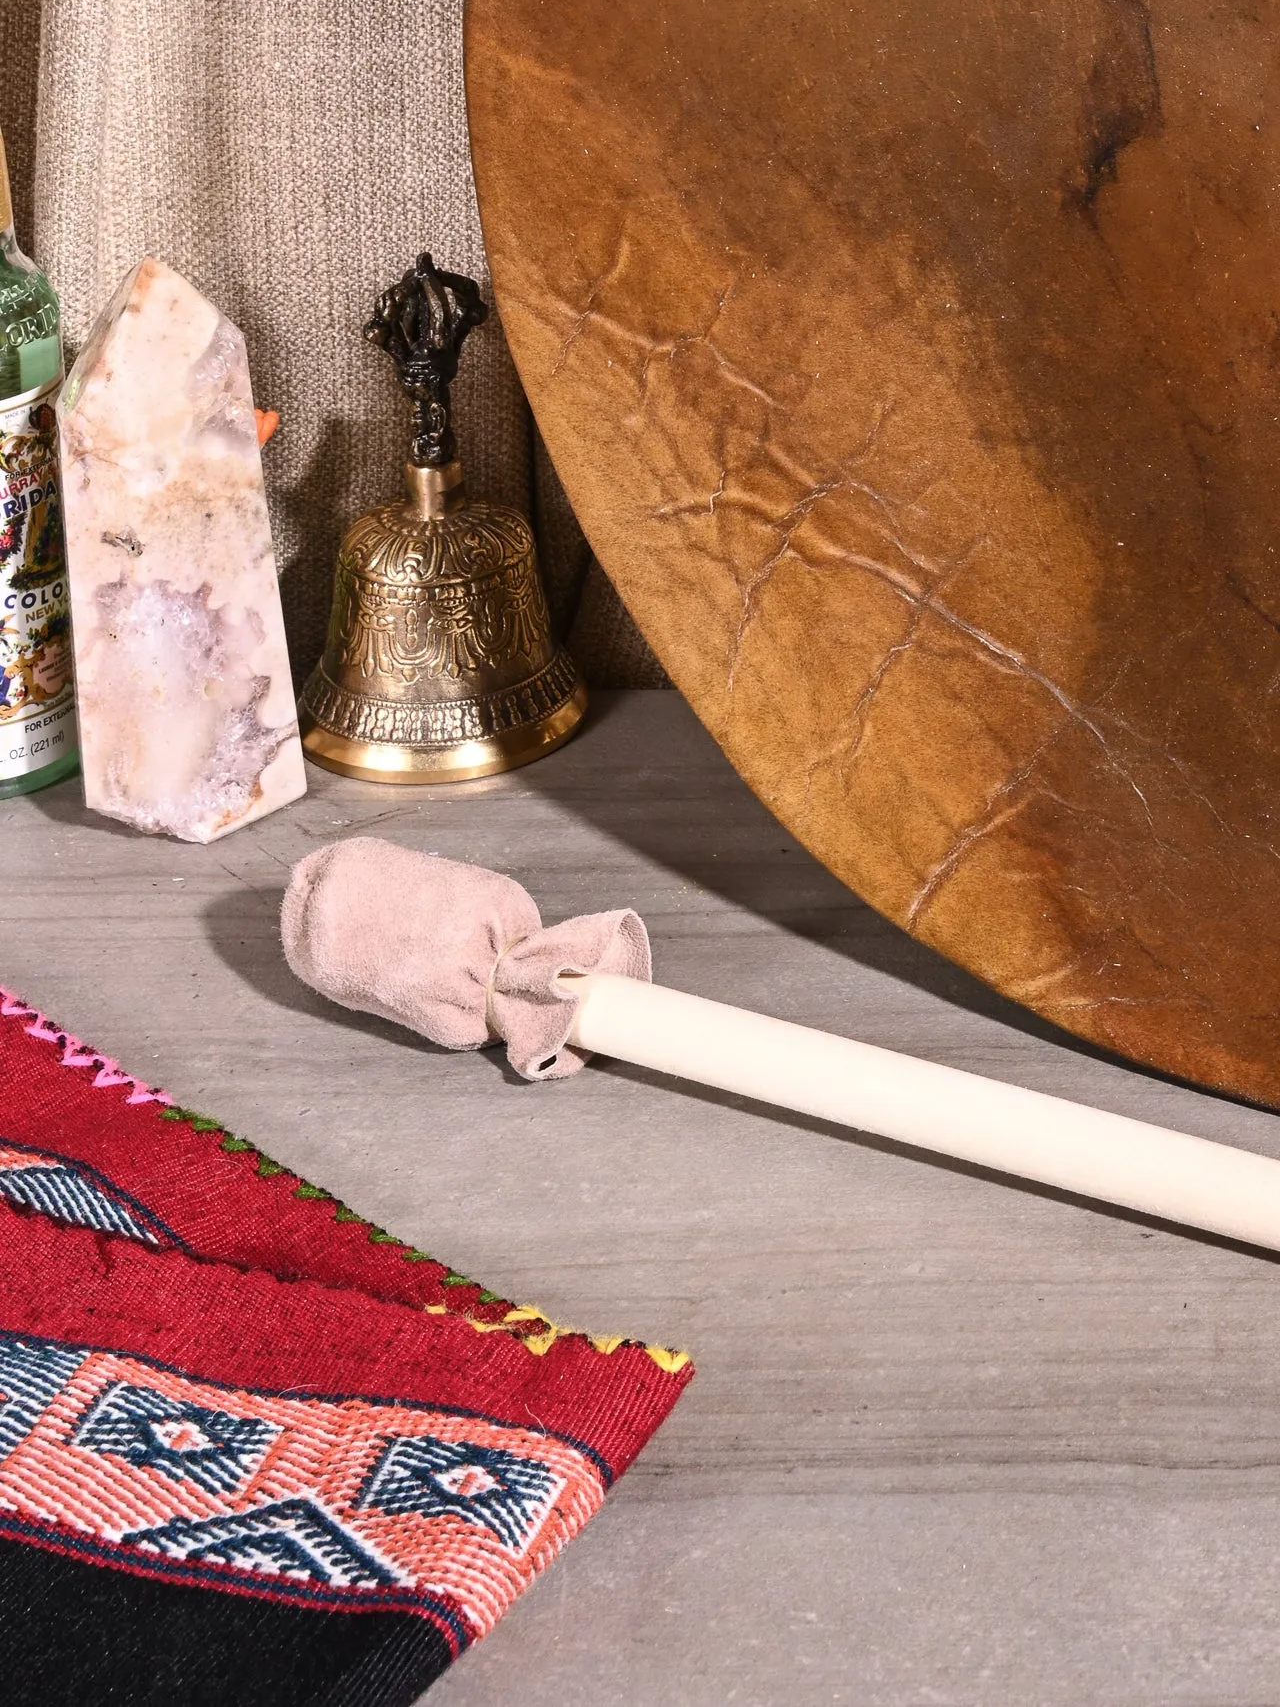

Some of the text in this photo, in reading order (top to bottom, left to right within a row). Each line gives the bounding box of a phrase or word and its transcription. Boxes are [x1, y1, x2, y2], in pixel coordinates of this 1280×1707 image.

[25, 601, 56, 624] NEW
[25, 720, 42, 733] FOR
[9, 729, 65, 760] OZ. (221 ml)
